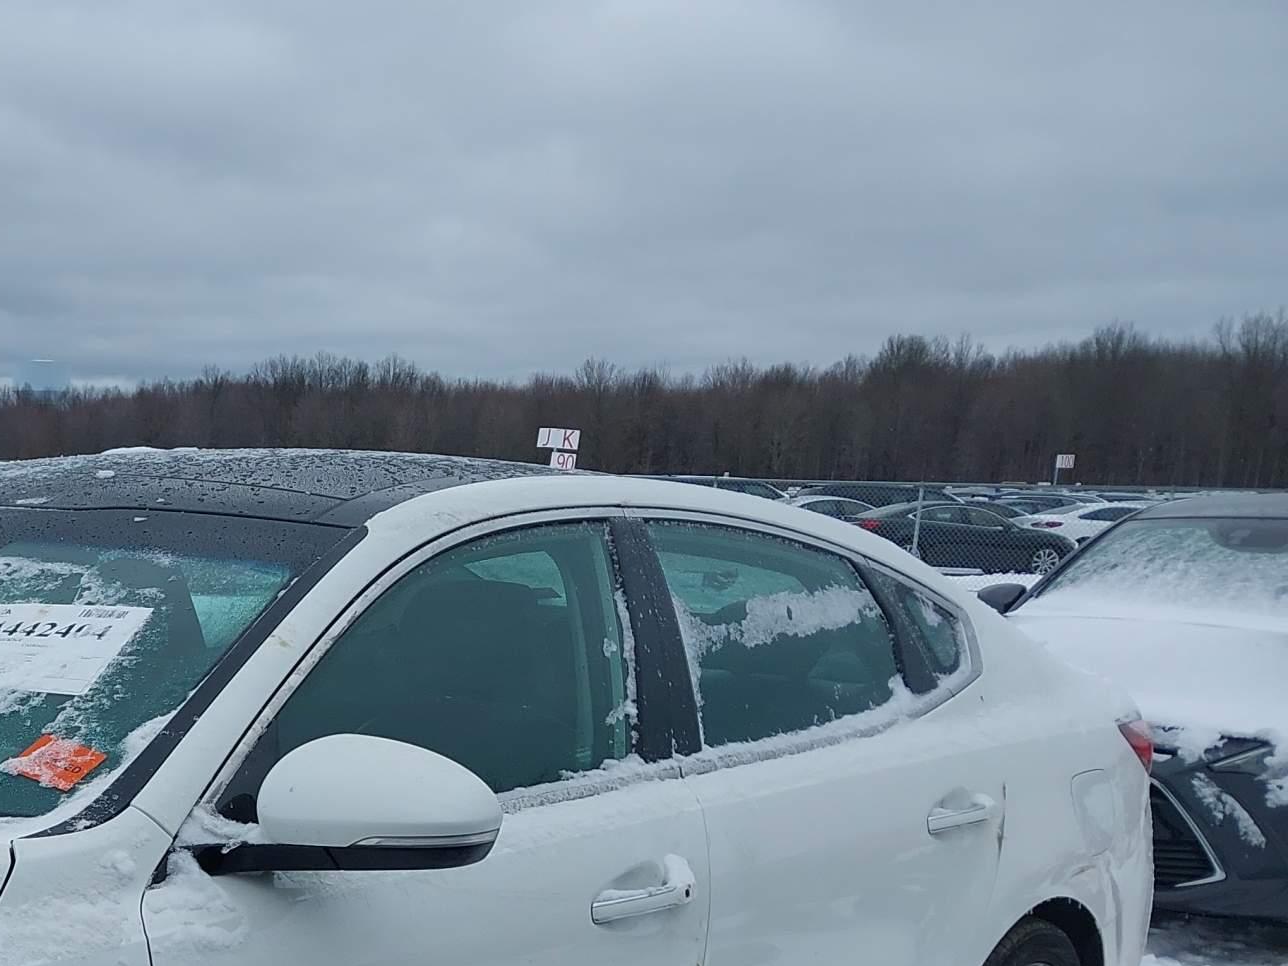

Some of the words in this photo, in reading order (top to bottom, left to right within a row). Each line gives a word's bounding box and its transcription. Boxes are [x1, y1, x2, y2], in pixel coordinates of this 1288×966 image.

[542, 429, 551, 446] J
[562, 430, 574, 448] K
[557, 454, 574, 470] 90
